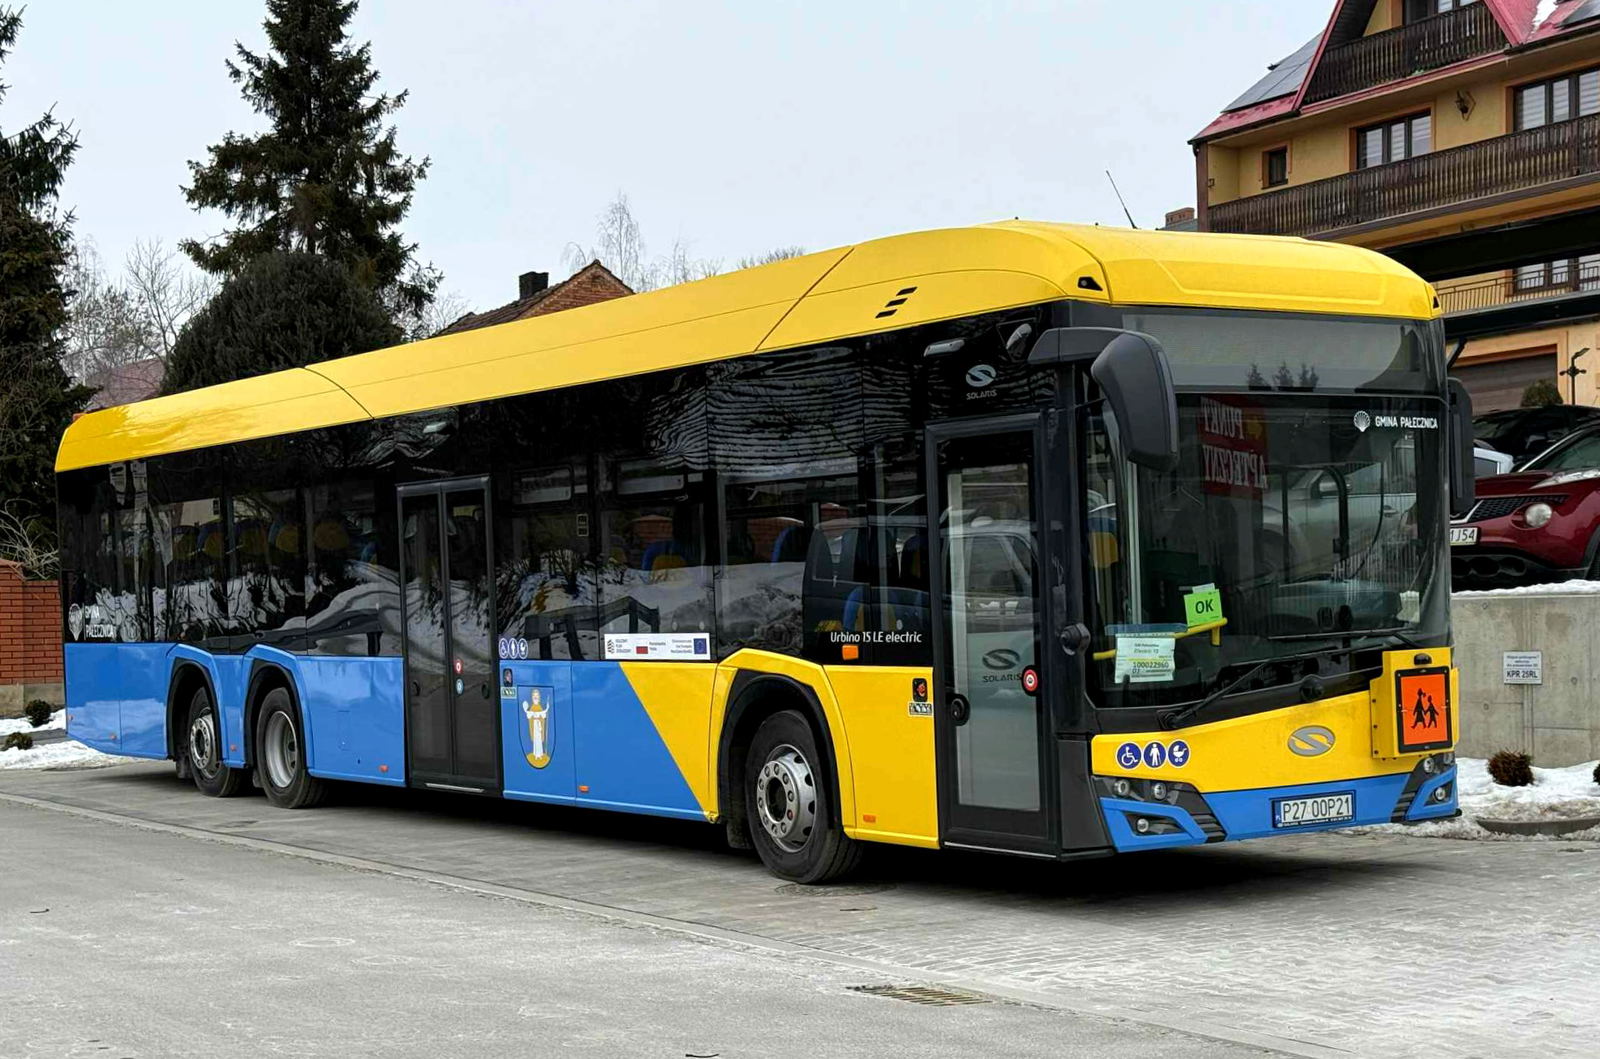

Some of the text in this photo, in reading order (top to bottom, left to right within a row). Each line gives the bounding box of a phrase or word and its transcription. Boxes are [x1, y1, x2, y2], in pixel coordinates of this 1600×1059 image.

[966, 389, 997, 400] SOLARIS
[1375, 416, 1398, 427] GMINA
[1195, 599, 1214, 614] OK
[830, 631, 922, 643] Urbino 15 LE electric
[982, 672, 1022, 683] SOLARIS
